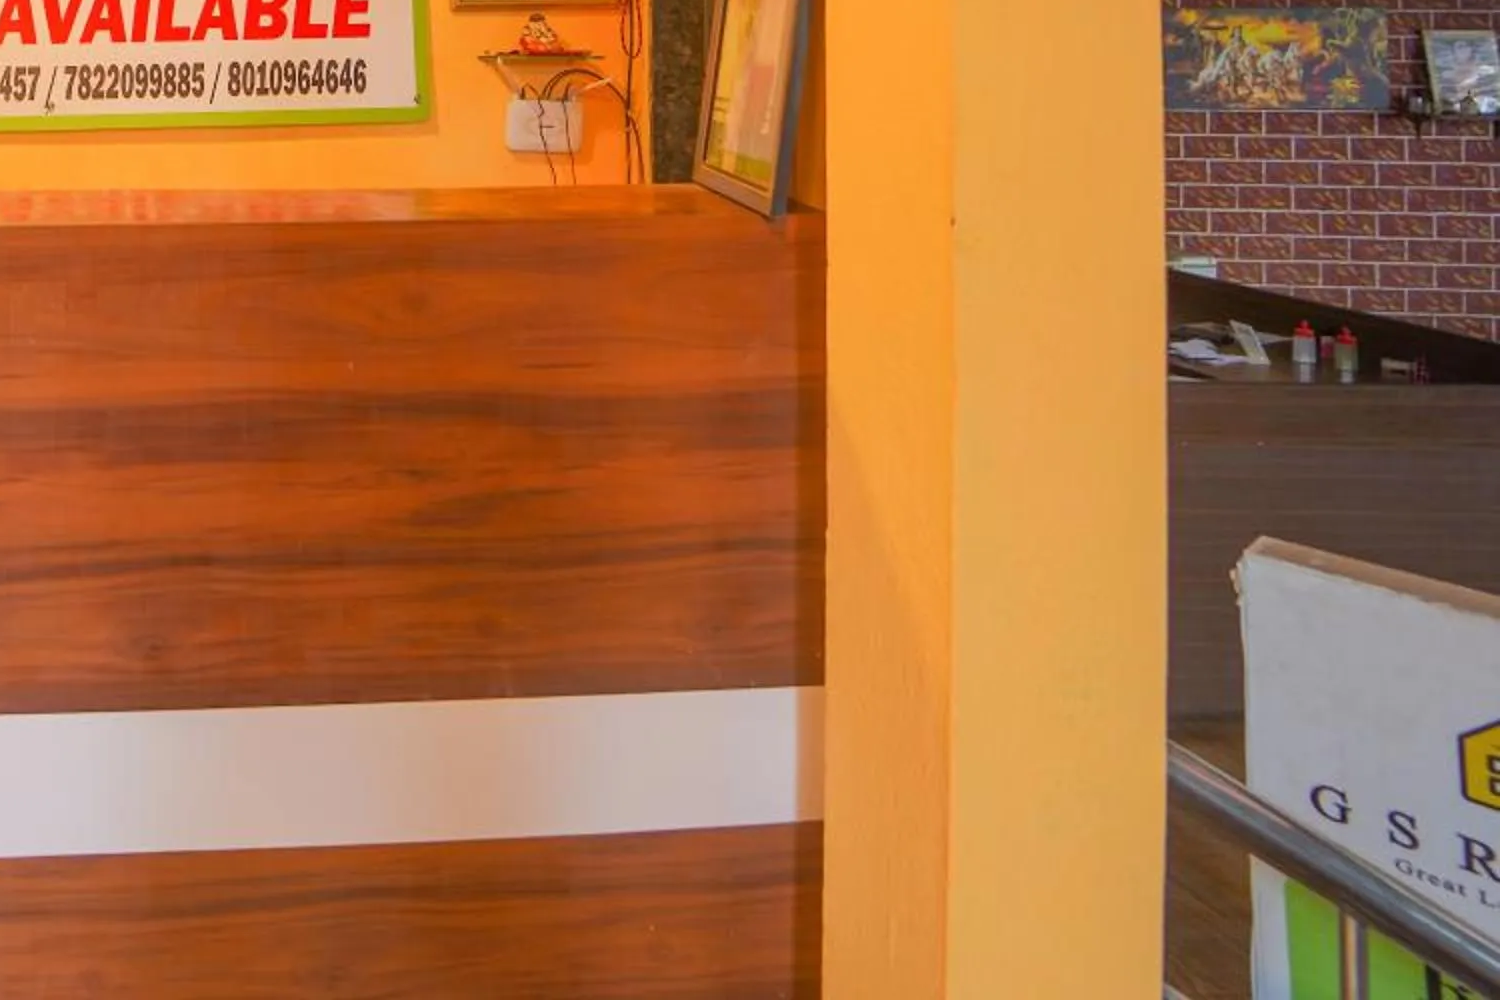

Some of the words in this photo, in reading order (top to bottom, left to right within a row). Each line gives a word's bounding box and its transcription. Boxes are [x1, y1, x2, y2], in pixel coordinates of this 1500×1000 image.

[63, 63, 205, 100] 7822099885
[227, 60, 368, 96] 8010964646
[1395, 858, 1468, 897] Great
